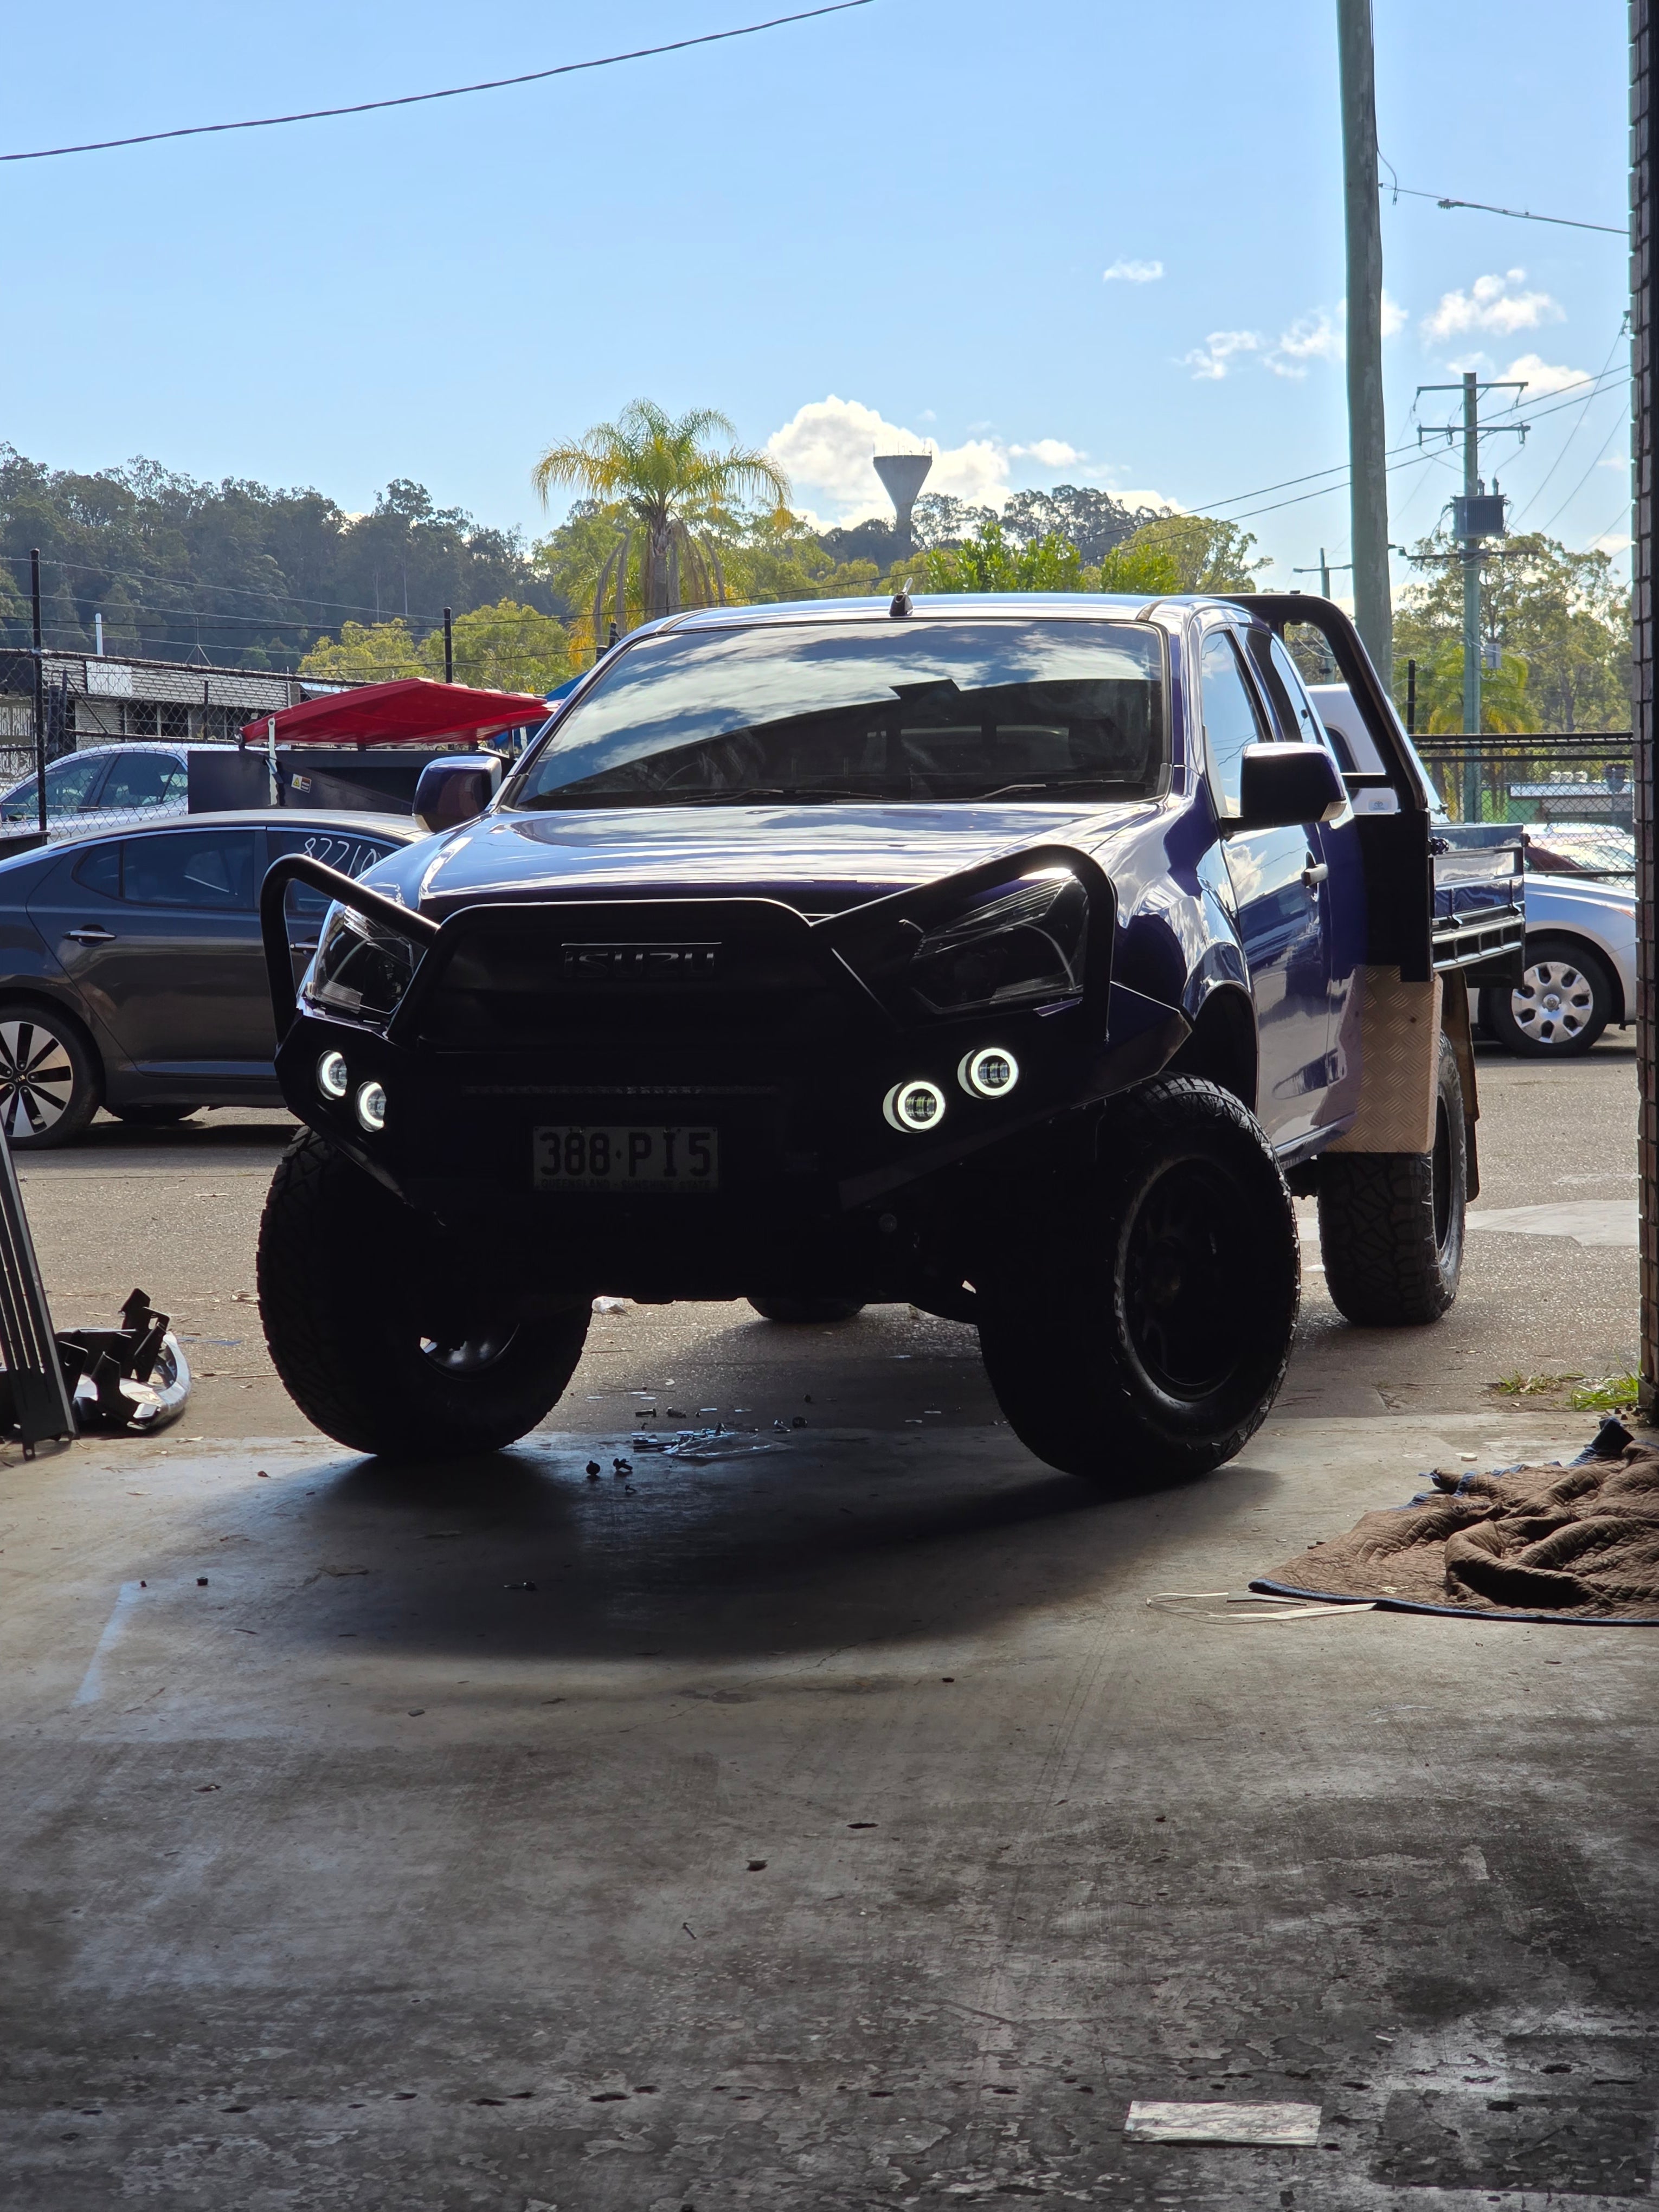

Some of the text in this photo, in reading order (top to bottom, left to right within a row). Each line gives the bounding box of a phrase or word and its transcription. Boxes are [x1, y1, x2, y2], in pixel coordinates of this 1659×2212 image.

[564, 951, 716, 978] ISUZU
[541, 1178, 610, 1190] QUEENSLAND
[621, 1179, 673, 1191] SUNSHINE
[679, 1179, 711, 1191] STATE
